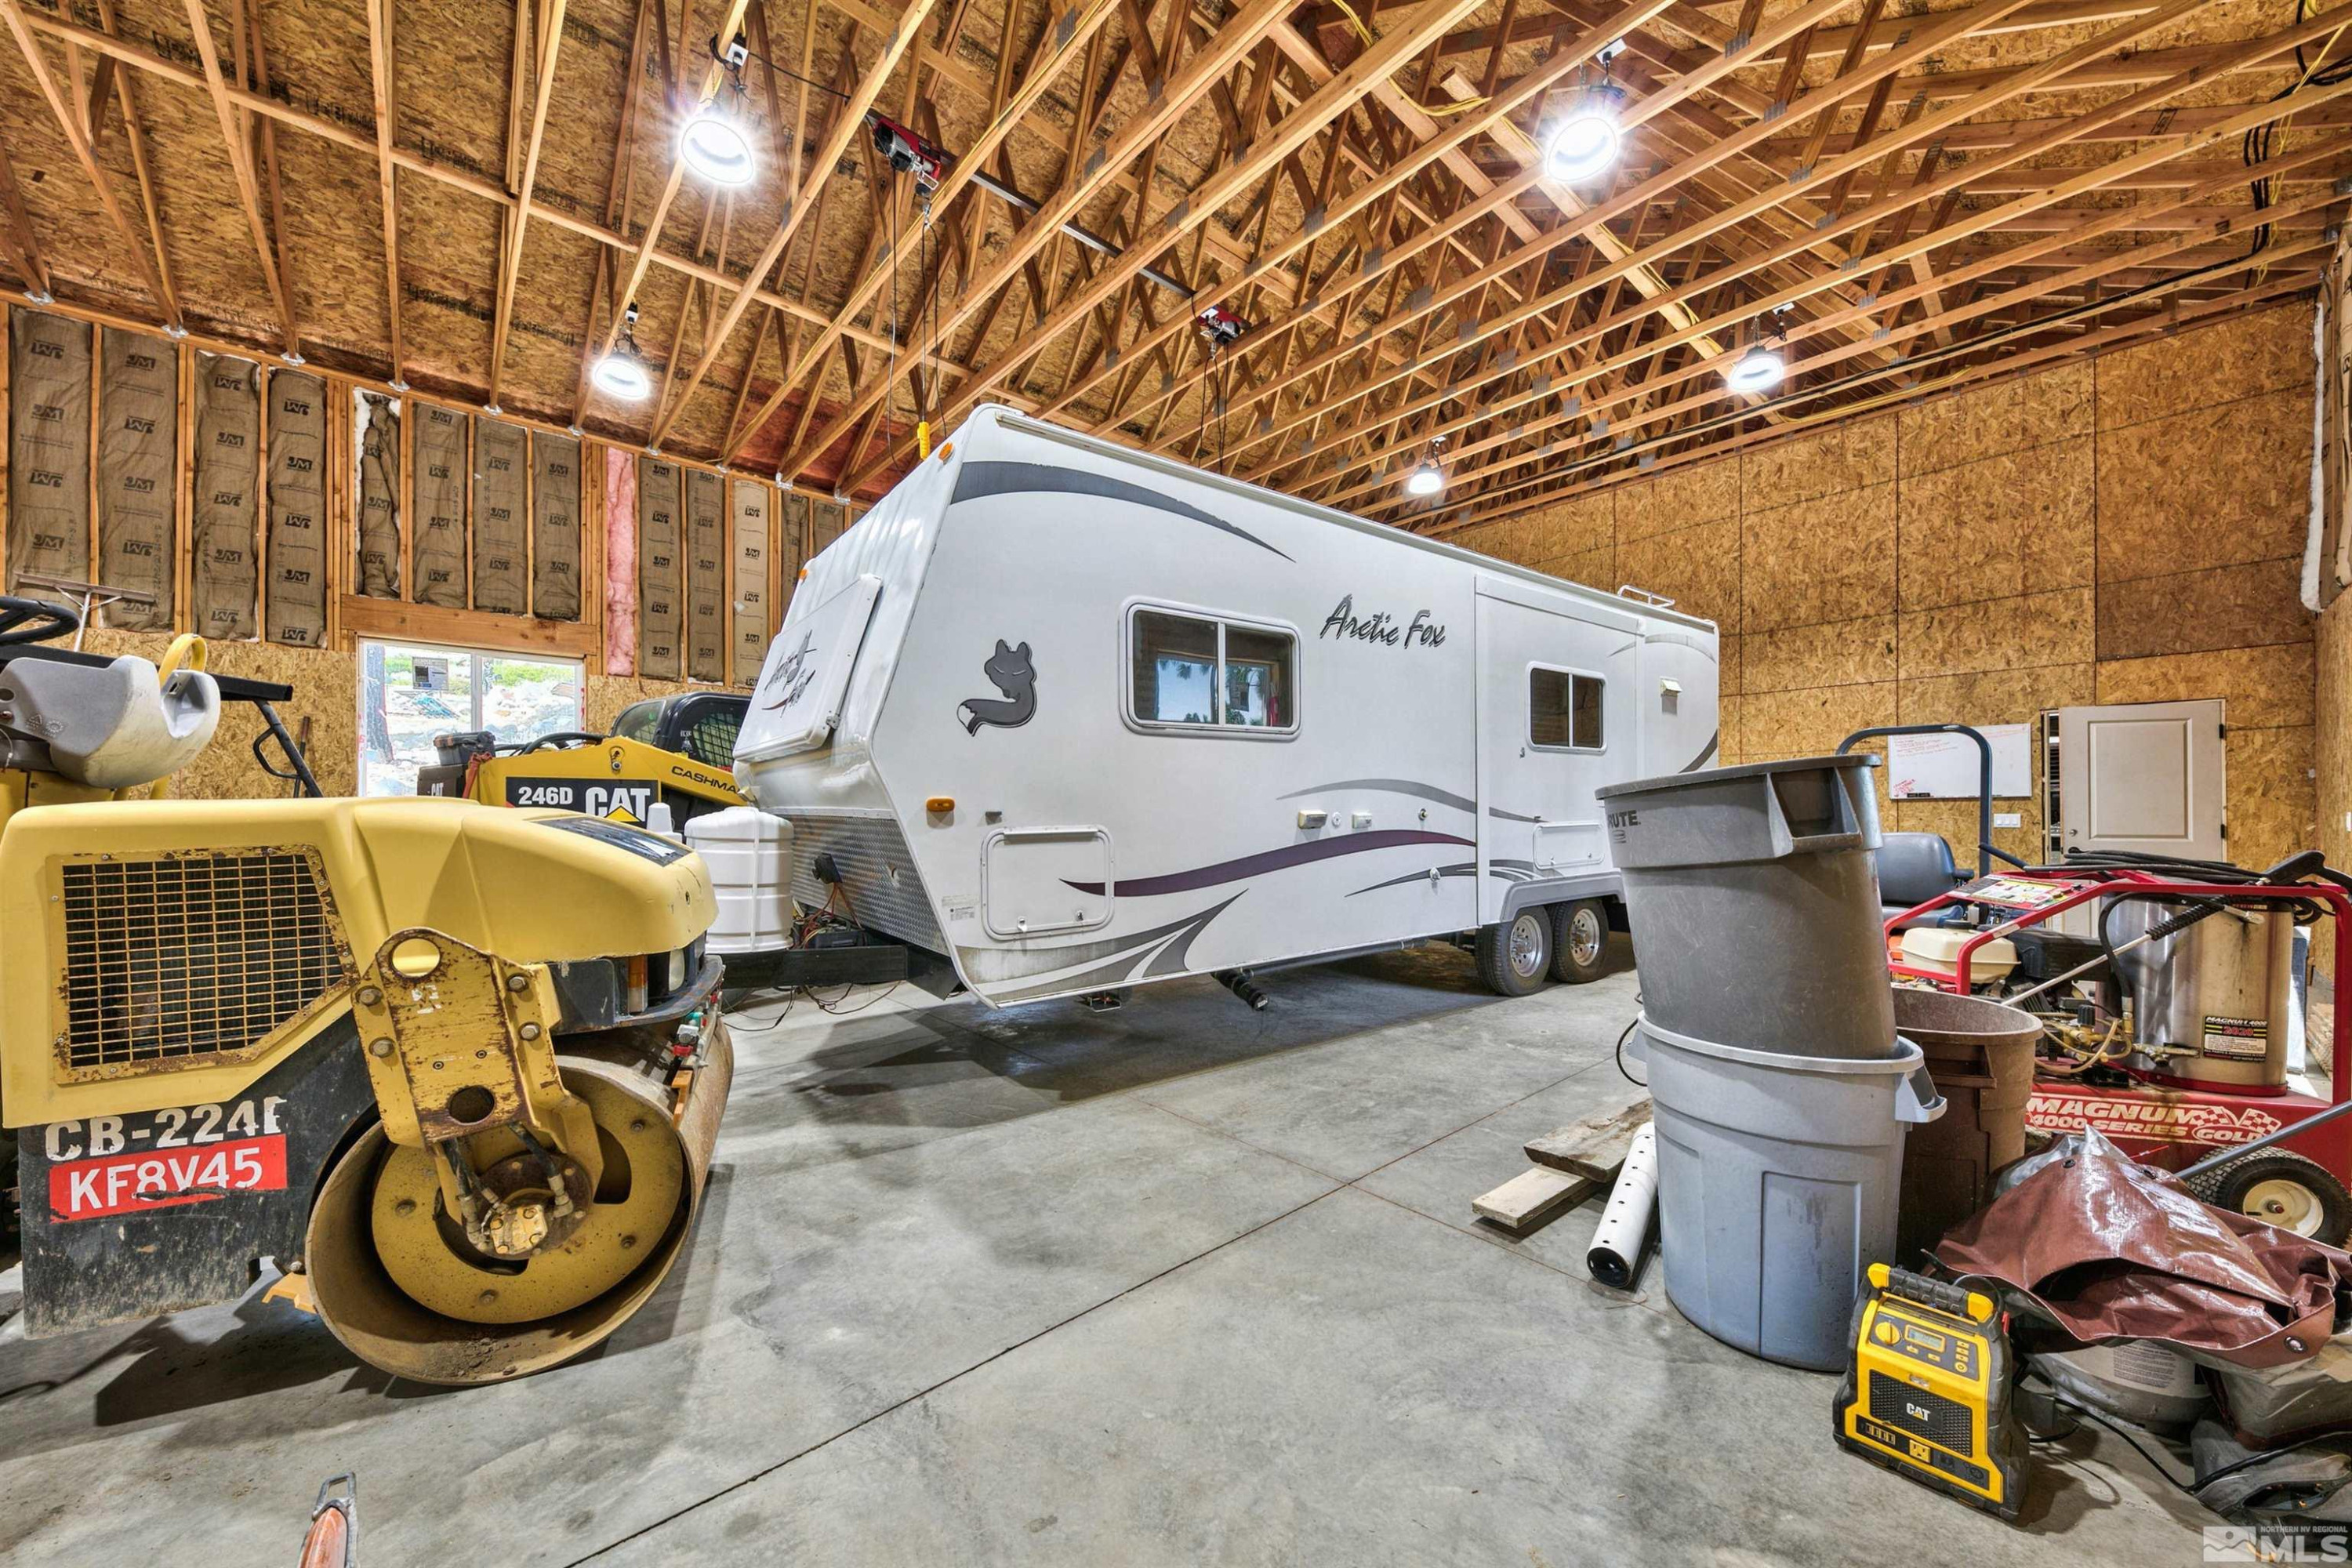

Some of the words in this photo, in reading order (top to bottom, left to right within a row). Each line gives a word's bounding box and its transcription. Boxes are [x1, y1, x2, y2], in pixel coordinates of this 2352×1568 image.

[31, 342, 65, 359] JM
[125, 354, 156, 371] JM
[215, 376, 241, 390] JM
[32, 404, 64, 420] JM
[284, 401, 310, 416] JM
[430, 410, 452, 425] JM
[124, 417, 155, 434] JM
[217, 432, 245, 447] JM
[287, 456, 313, 470] JM
[489, 458, 510, 471] JM
[549, 463, 568, 475] JM
[429, 466, 449, 479] JM
[653, 465, 670, 477] JM
[30, 472, 63, 488] JM
[124, 476, 154, 491] JM
[214, 494, 242, 507] JM
[368, 496, 390, 511] JM
[490, 507, 510, 521] JM
[745, 507, 760, 517] JM
[285, 514, 311, 529] JM
[430, 517, 450, 528] JM
[33, 534, 65, 549] JM
[122, 542, 153, 556] JM
[215, 549, 242, 562] JM
[745, 548, 760, 558] JM
[550, 561, 570, 573] JM
[653, 556, 670, 566] JM
[285, 569, 310, 583] JM
[429, 571, 449, 582] JM
[745, 593, 760, 602] JM
[652, 604, 669, 614] JM
[211, 611, 239, 623] JM
[1320, 593, 1399, 646] Arctic
[1404, 609, 1445, 649] Fox
[281, 629, 307, 641] JM
[745, 633, 760, 643] JM
[652, 646, 670, 656] JM
[671, 766, 739, 793] CASHMA
[518, 786, 573, 806] 246D
[586, 787, 651, 822] CAT
[2026, 1098, 2201, 1125] MAGNUM
[2029, 1115, 2087, 1130] 4000
[2092, 1119, 2189, 1137] SERIES
[2196, 1129, 2263, 1142] GOLD
[71, 1147, 263, 1213] KF8V45
[1906, 1403, 1931, 1421] CAT
